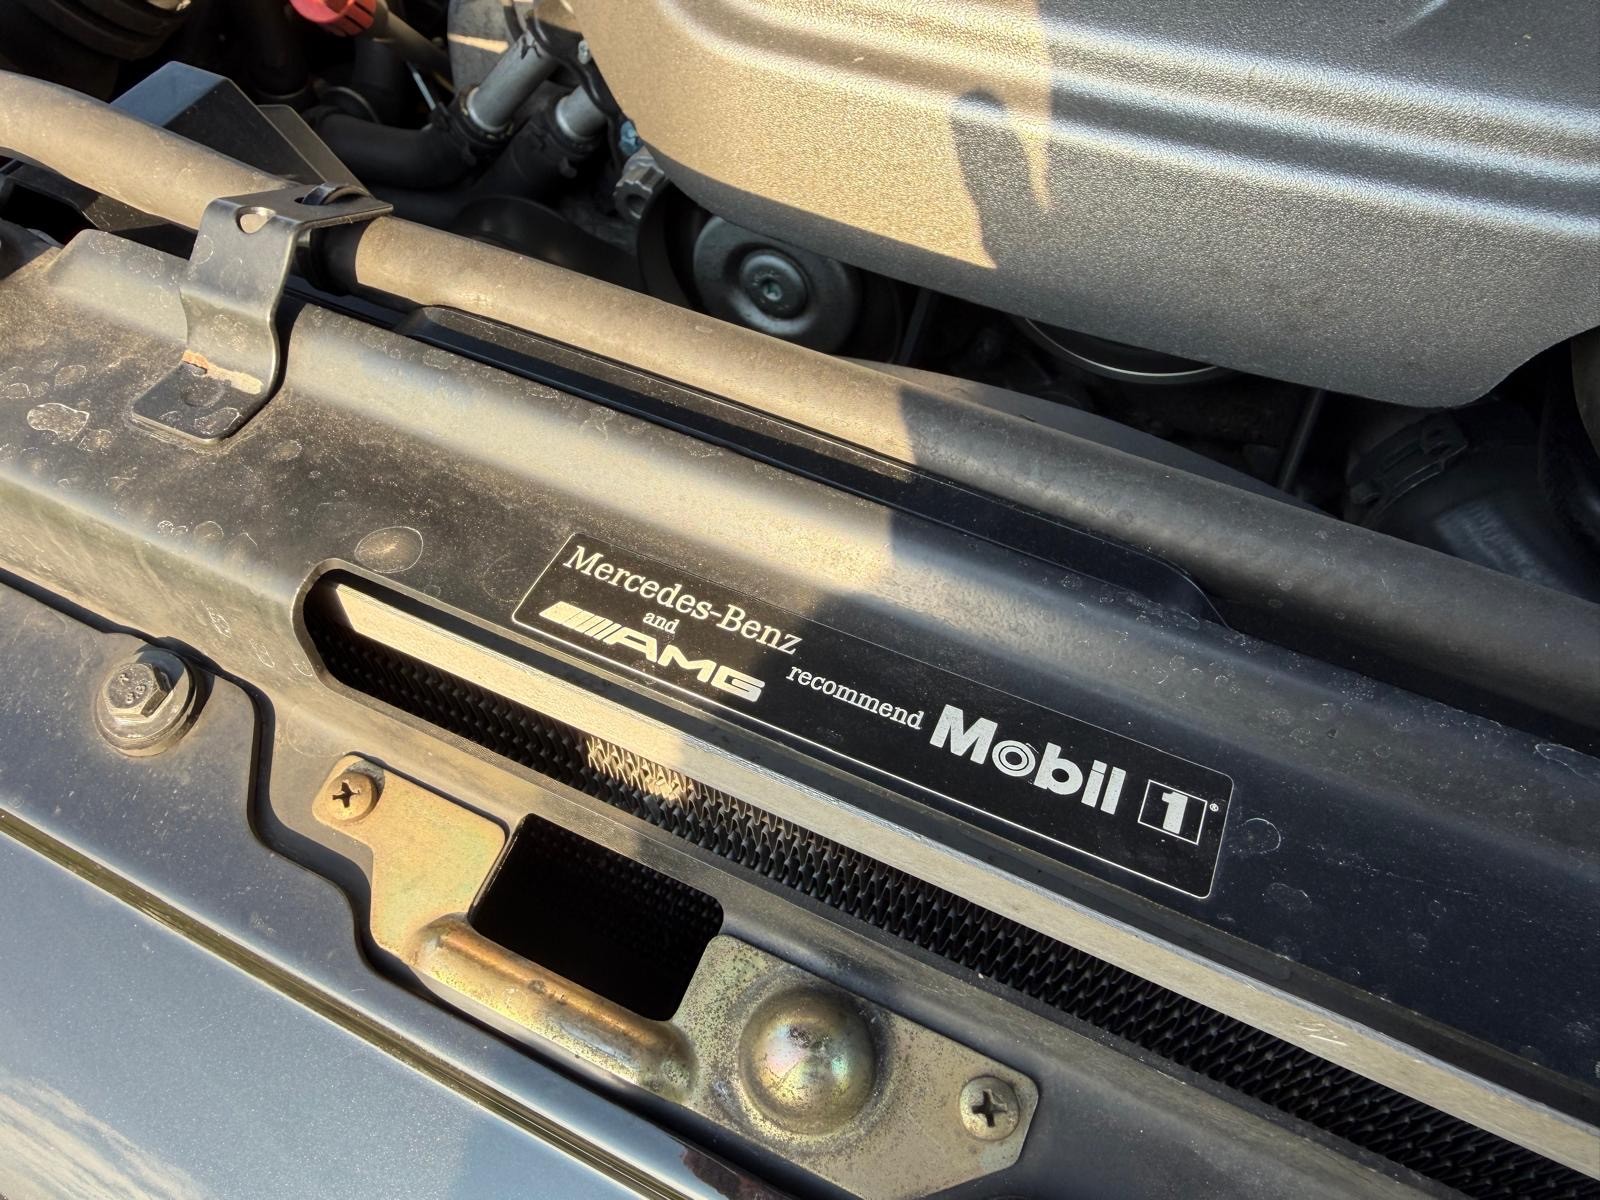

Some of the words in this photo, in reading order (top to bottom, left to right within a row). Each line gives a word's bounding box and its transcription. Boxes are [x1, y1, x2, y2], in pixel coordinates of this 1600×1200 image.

[563, 545, 802, 655] Mercedes-Benz
[642, 611, 680, 634] and
[601, 624, 766, 703] AMG
[786, 665, 924, 731] recommend
[929, 704, 1127, 815] Mobil
